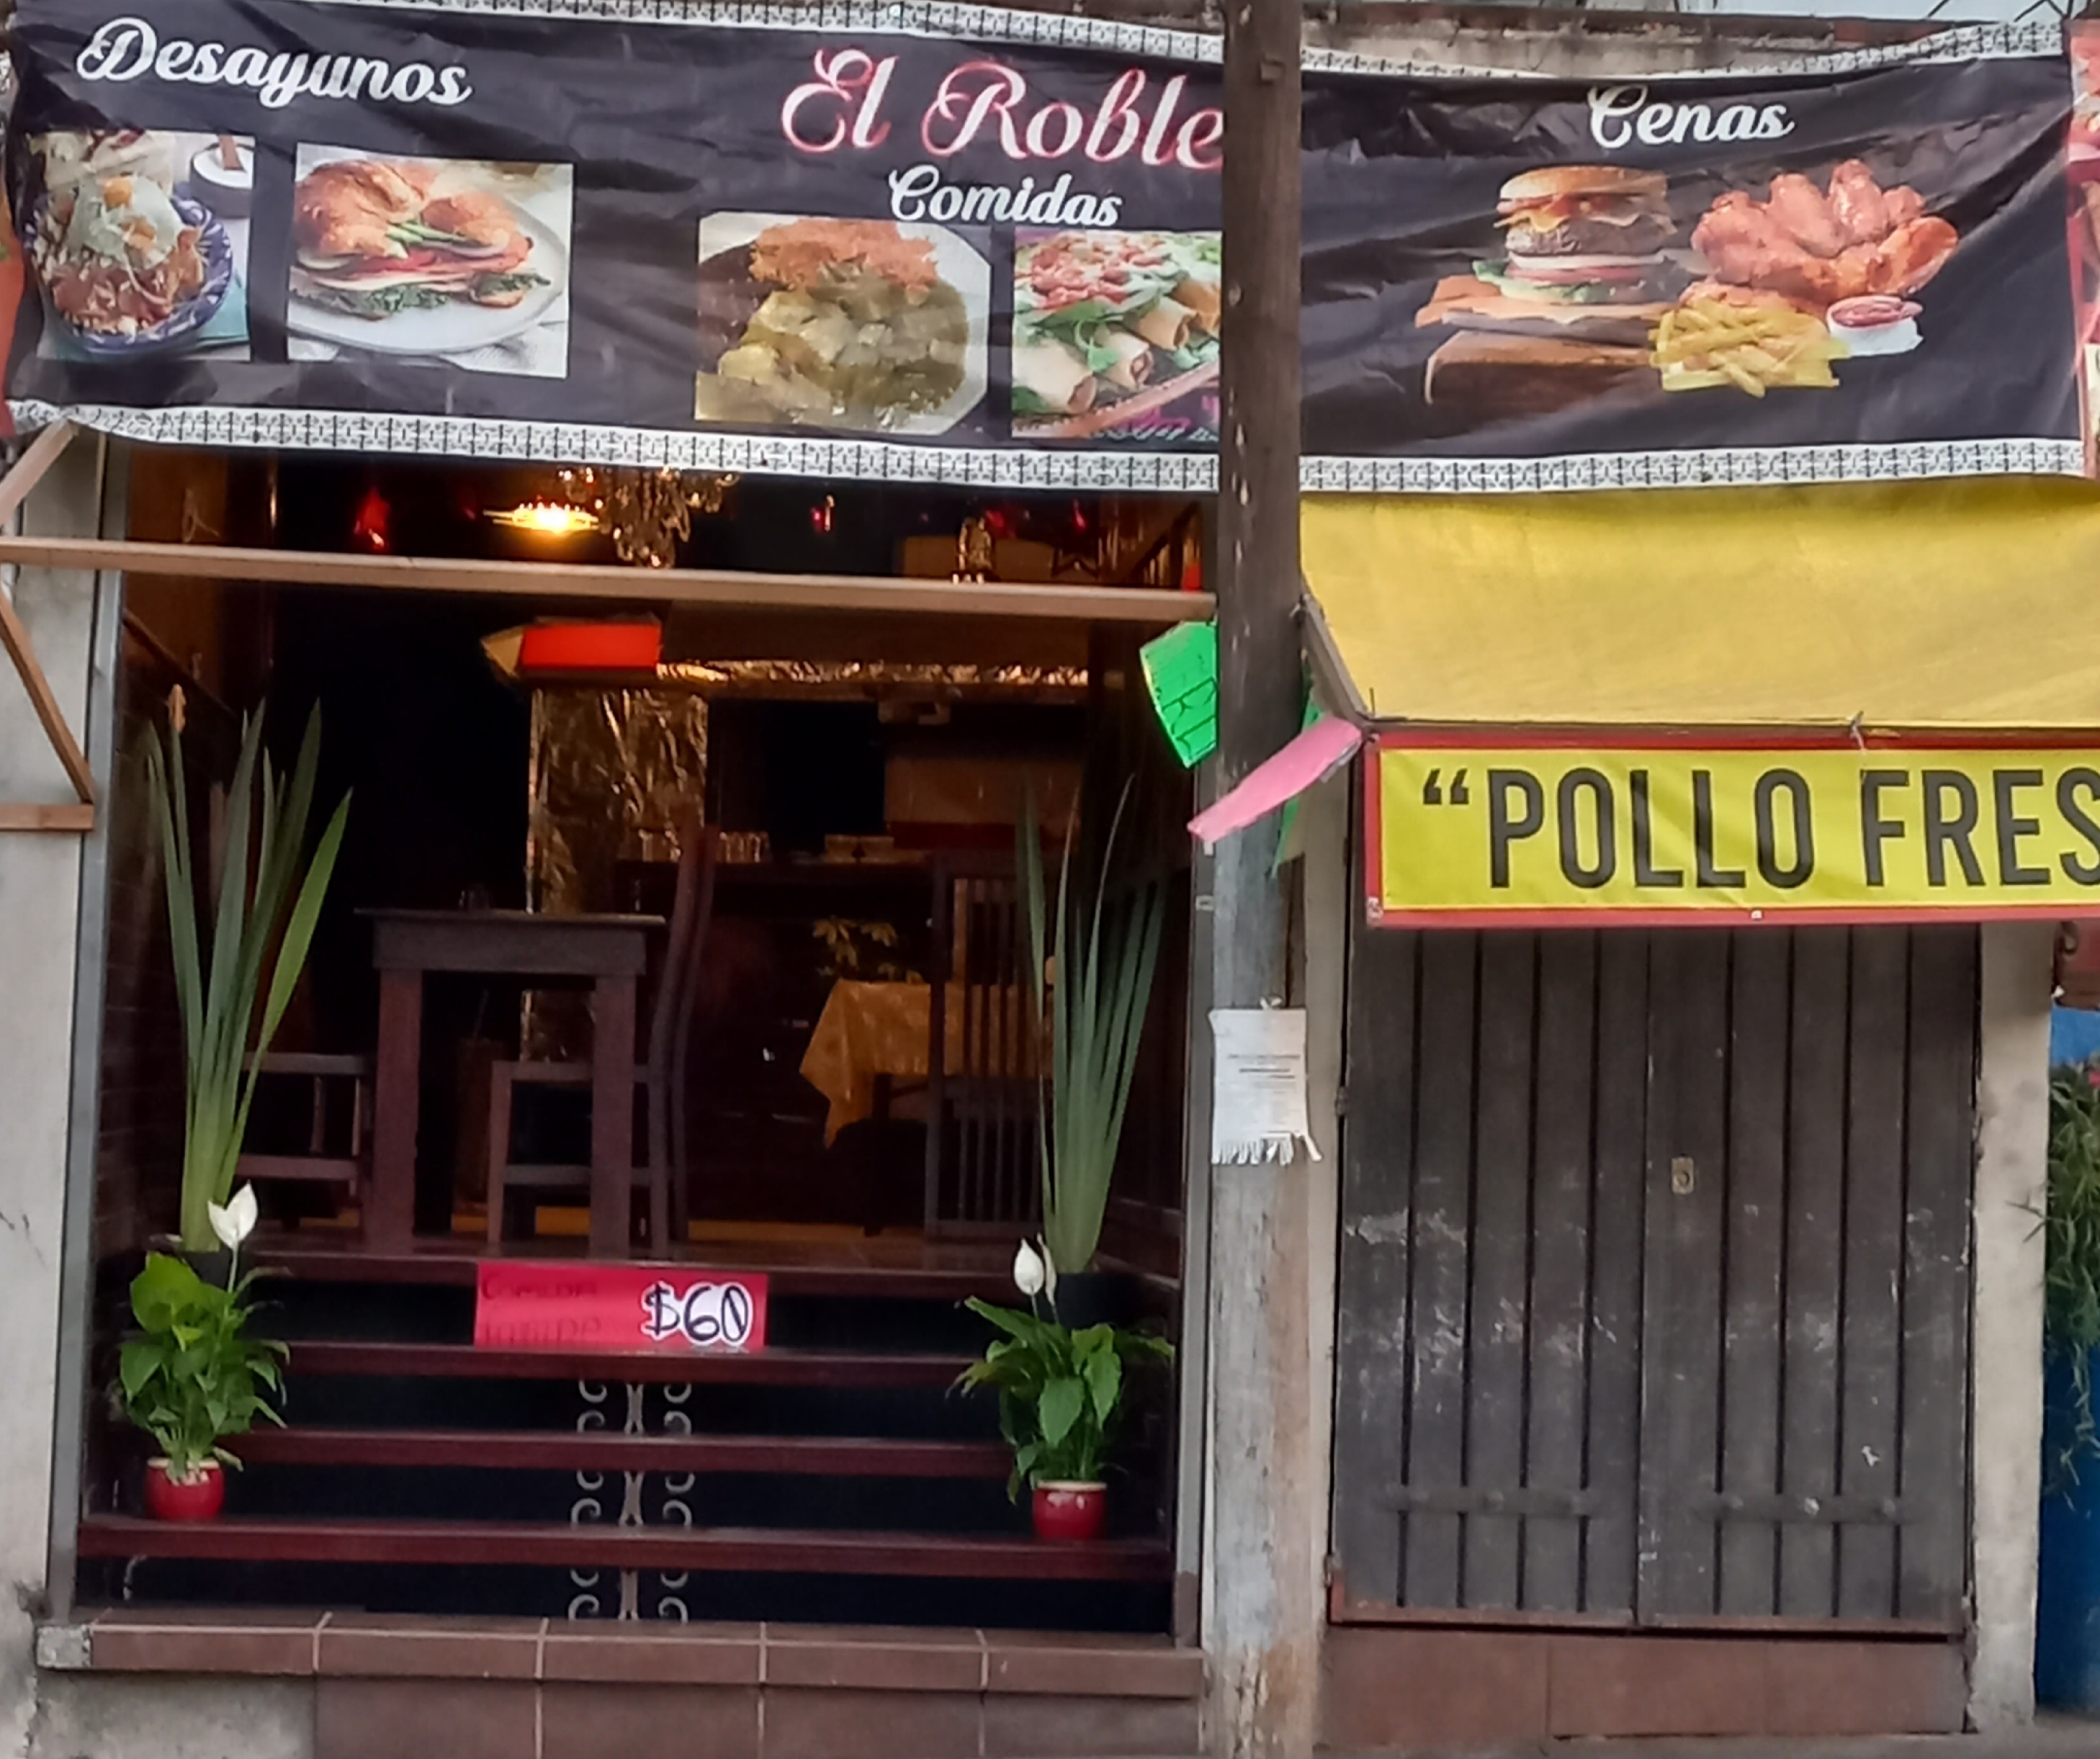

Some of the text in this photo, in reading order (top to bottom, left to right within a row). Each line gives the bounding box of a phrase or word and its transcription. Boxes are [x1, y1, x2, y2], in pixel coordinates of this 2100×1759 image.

[76, 17, 473, 108] Desayunos
[781, 48, 1222, 169] El Roble
[1587, 84, 1795, 148] Cenas
[888, 164, 1123, 227] Comidas
[642, 1282, 752, 1345] $60
